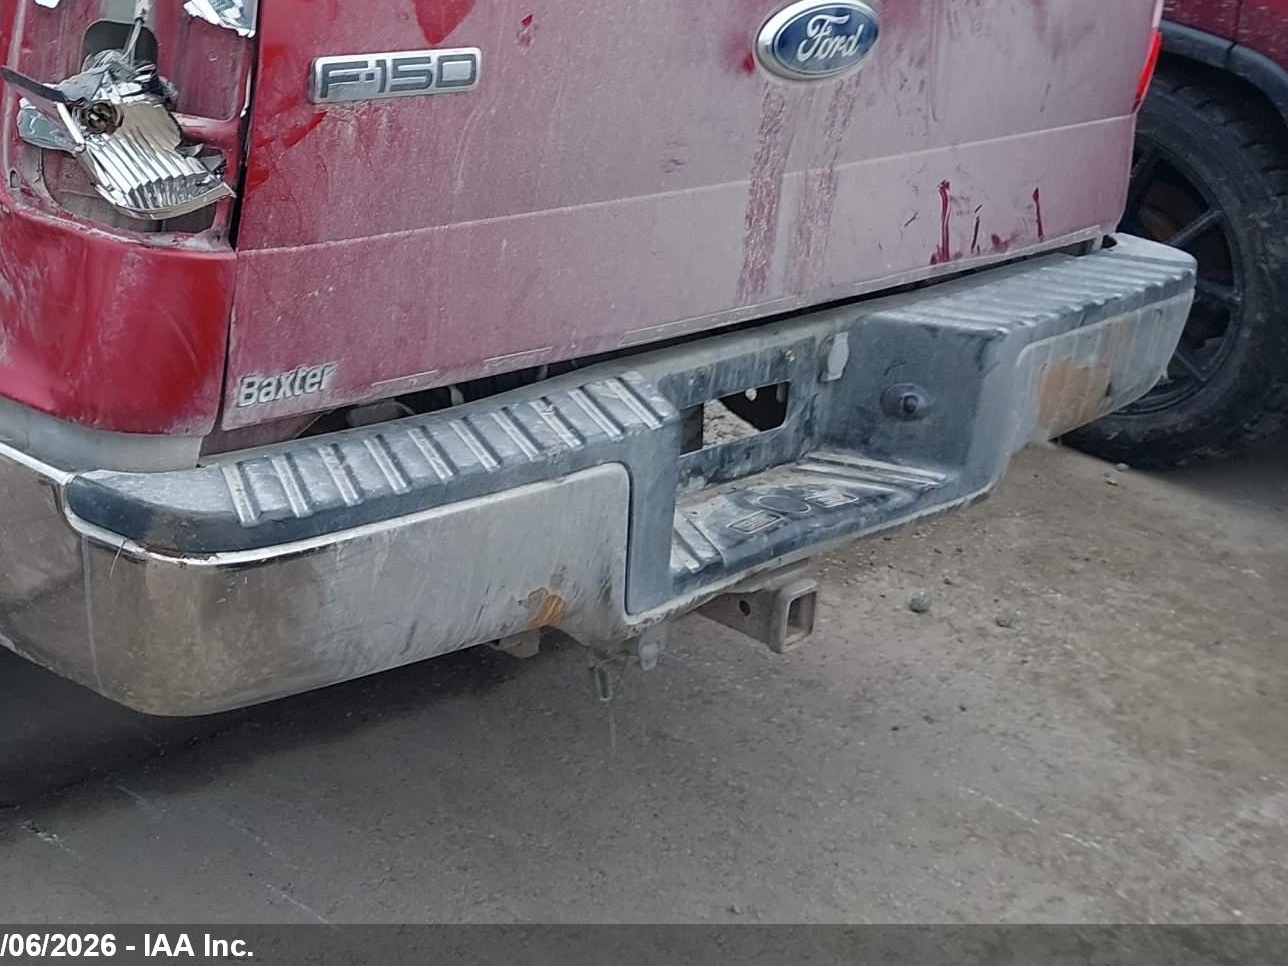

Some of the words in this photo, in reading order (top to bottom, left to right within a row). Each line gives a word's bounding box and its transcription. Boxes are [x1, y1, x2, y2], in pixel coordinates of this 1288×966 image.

[796, 14, 865, 62] Ford
[319, 53, 478, 99] F-150
[236, 362, 338, 408] Baxter
